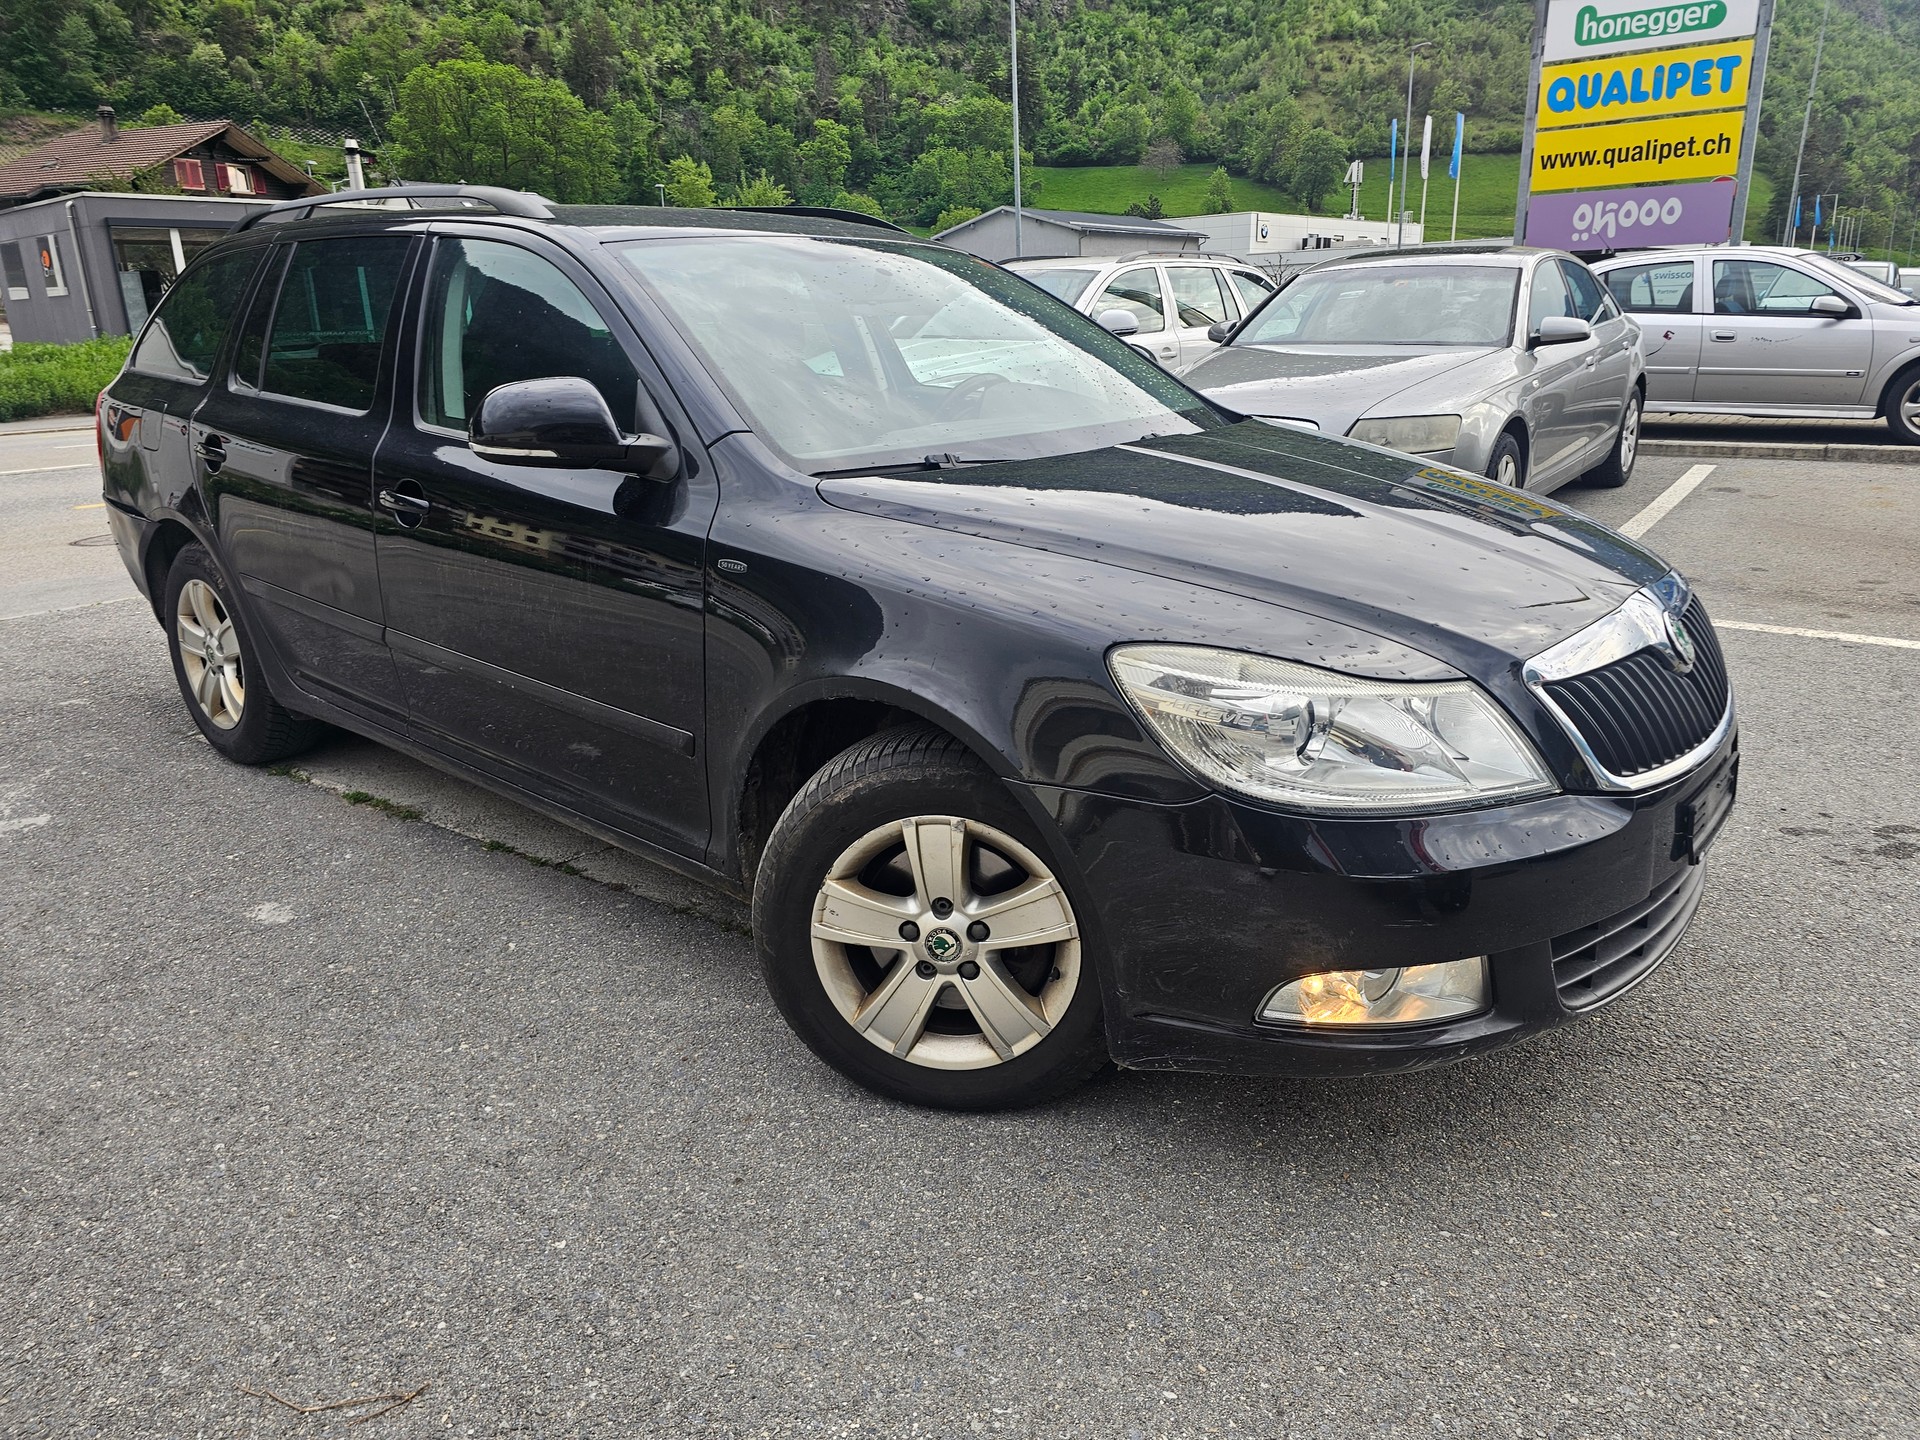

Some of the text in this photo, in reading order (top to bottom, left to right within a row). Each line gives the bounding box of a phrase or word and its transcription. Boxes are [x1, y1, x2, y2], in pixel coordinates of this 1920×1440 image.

[1582, 2, 1717, 40] honegger
[1547, 55, 1742, 113] QUALIPET
[1540, 133, 1731, 170] www.qualipet.ch
[1654, 270, 1693, 280] swissco
[728, 563, 744, 571] YEARS
